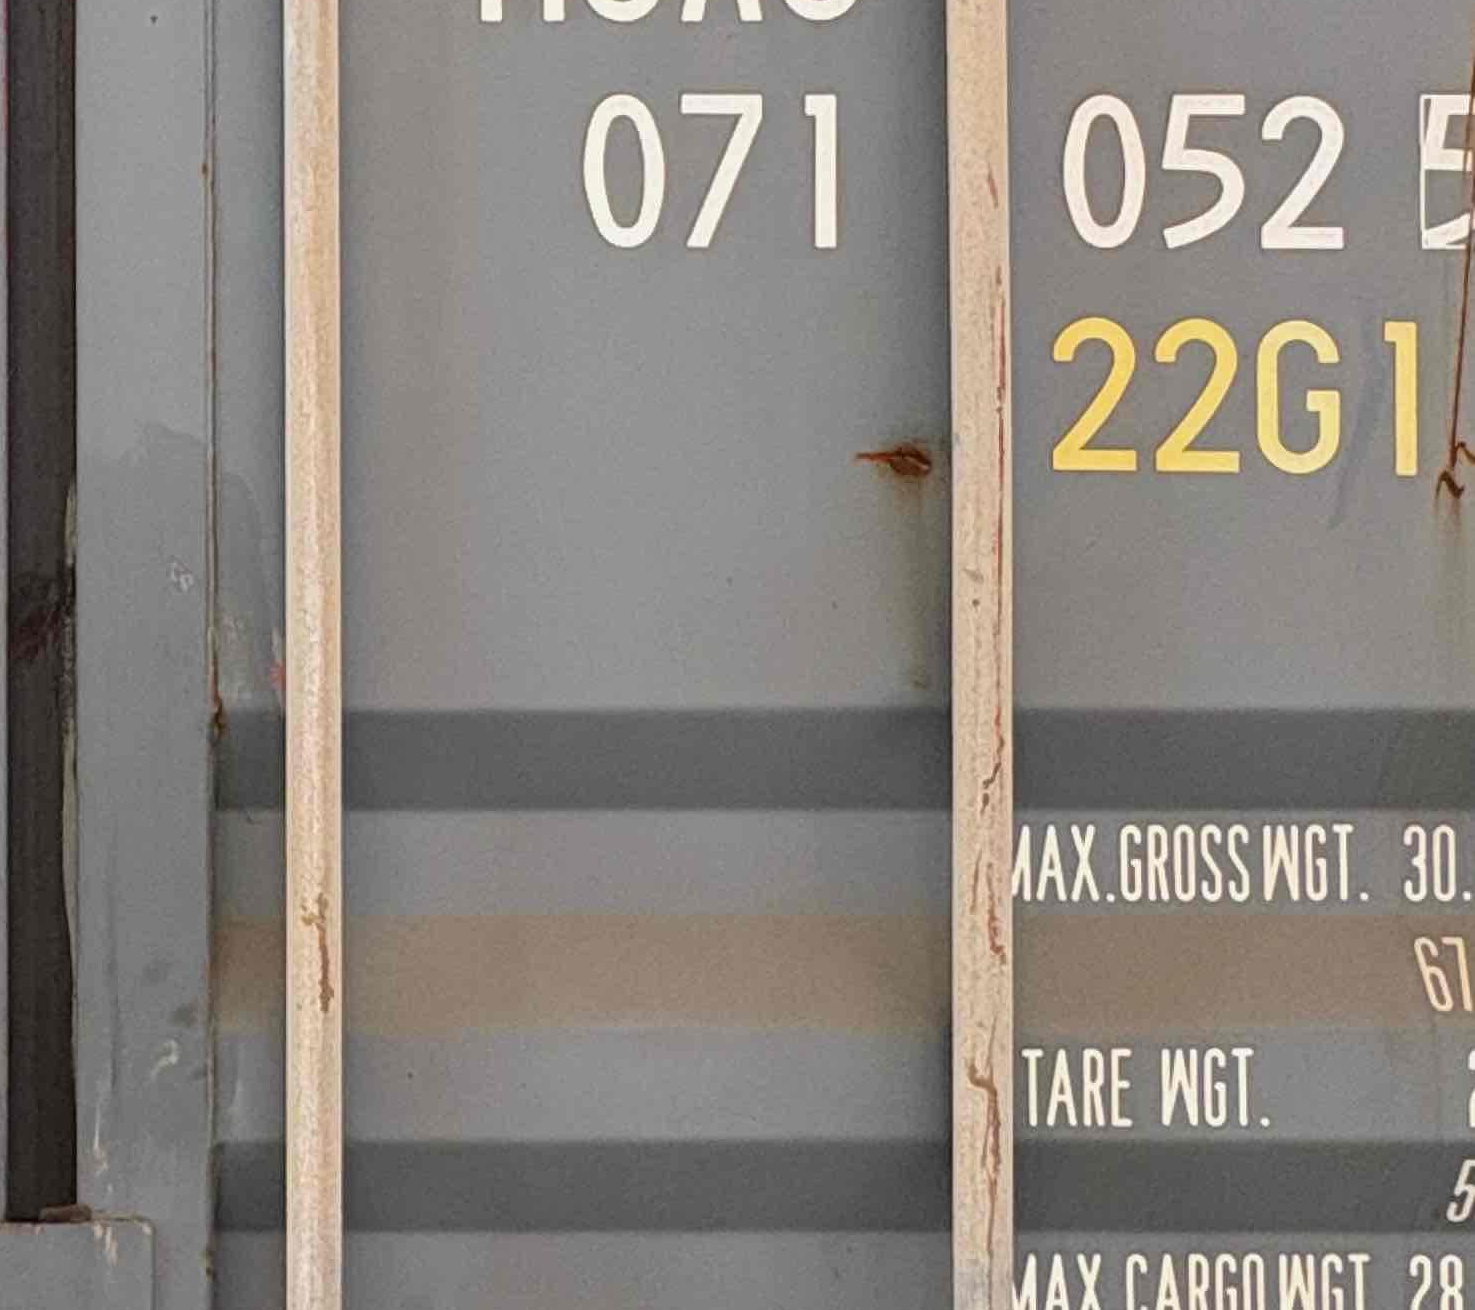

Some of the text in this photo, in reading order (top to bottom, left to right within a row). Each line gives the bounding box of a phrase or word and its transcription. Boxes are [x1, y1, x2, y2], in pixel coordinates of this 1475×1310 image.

[583, 93, 837, 248] 071
[1063, 94, 1344, 249] 052
[1052, 317, 1418, 476] 22G1
[1022, 1048, 1270, 1127] TARE WGT.
